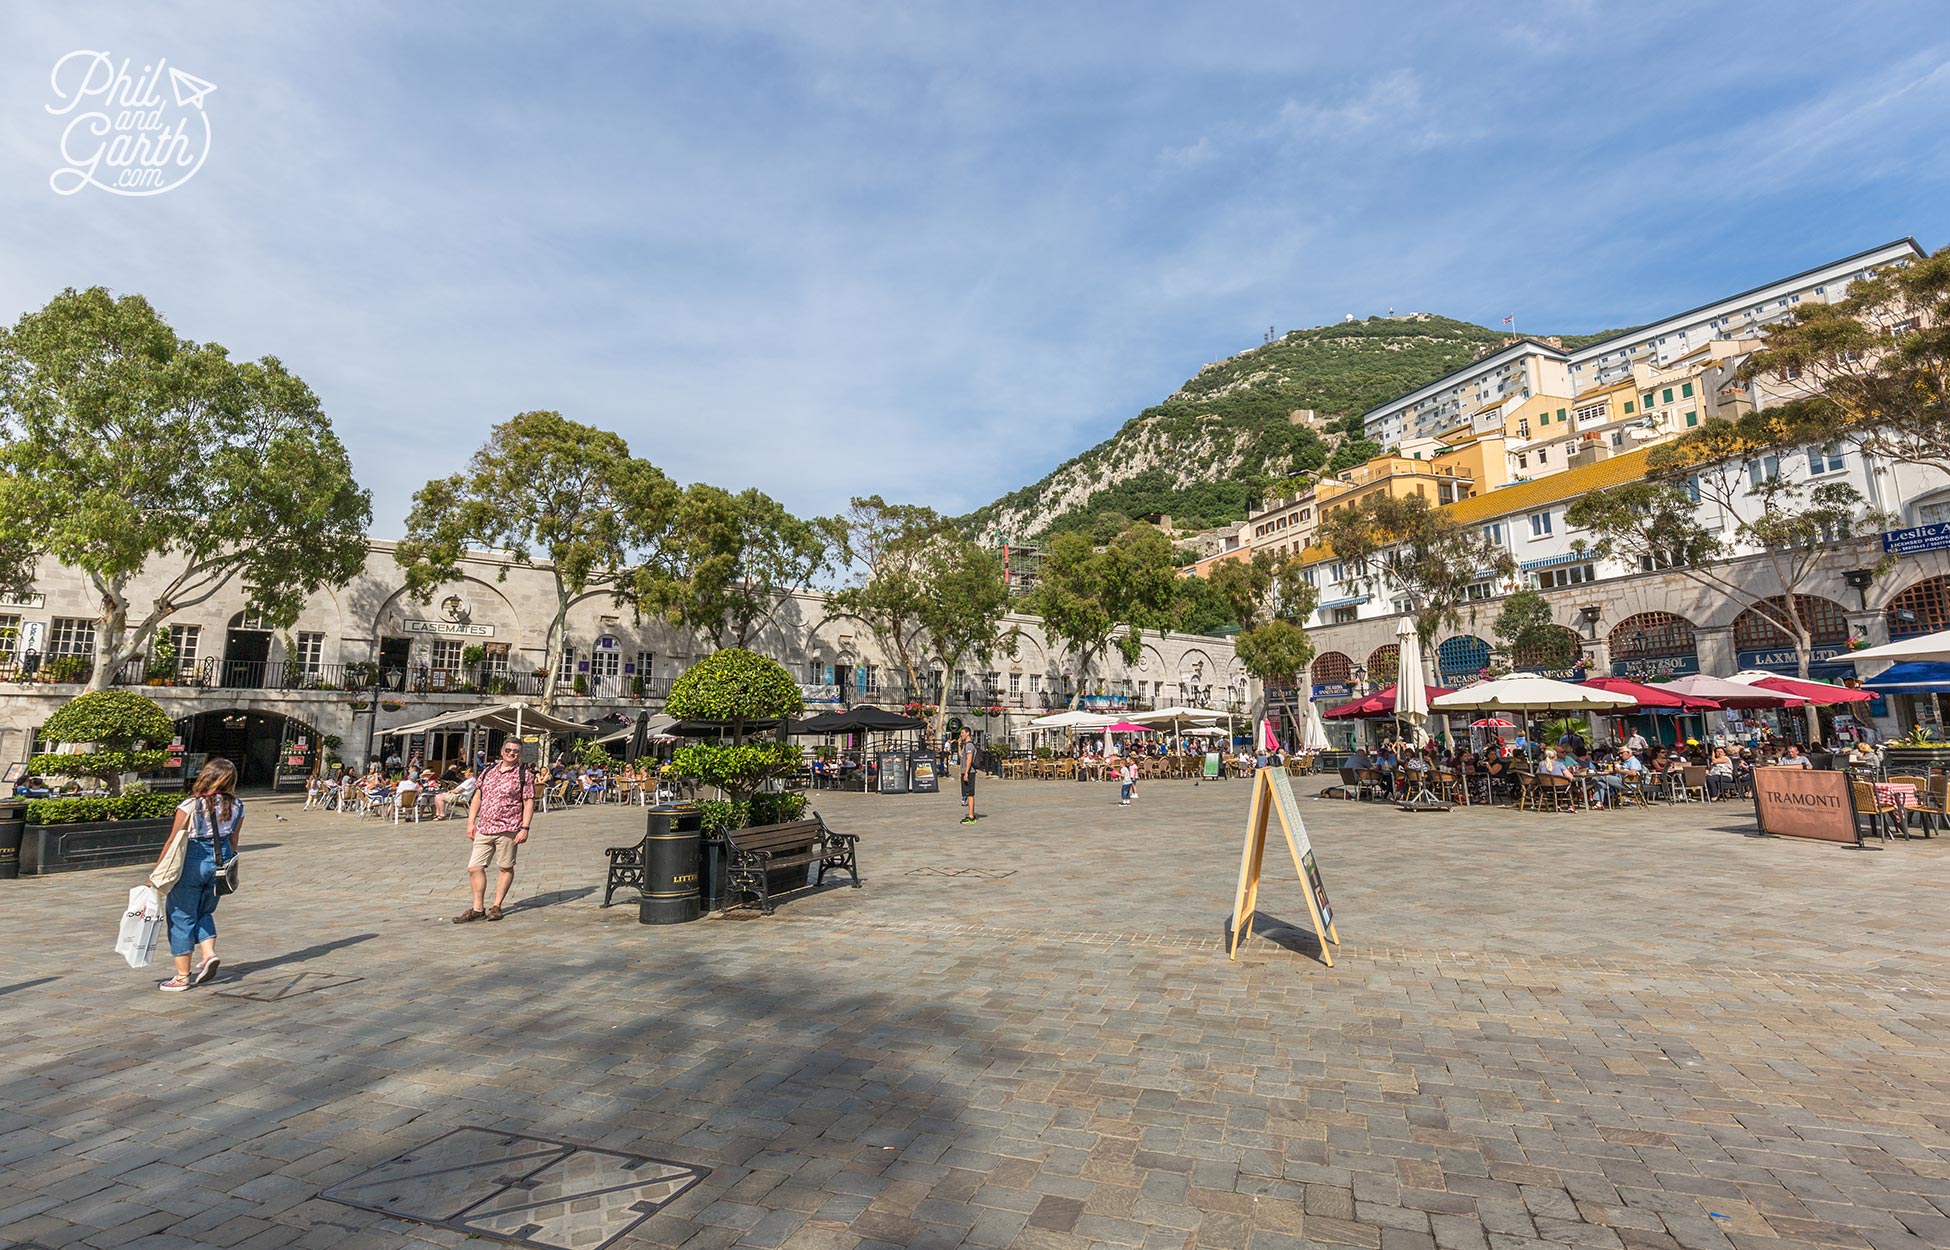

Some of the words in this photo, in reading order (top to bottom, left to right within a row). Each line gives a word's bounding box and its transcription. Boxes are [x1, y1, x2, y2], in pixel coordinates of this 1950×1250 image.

[1887, 527, 1936, 542] Leslie
[1890, 539, 1923, 548] LICENSED
[412, 622, 487, 635] CASEMATES
[28, 623, 37, 651] CRAF
[1755, 652, 1798, 665] LAXM
[1811, 649, 1839, 661] LTD
[1766, 791, 1840, 808] TRAMONTI
